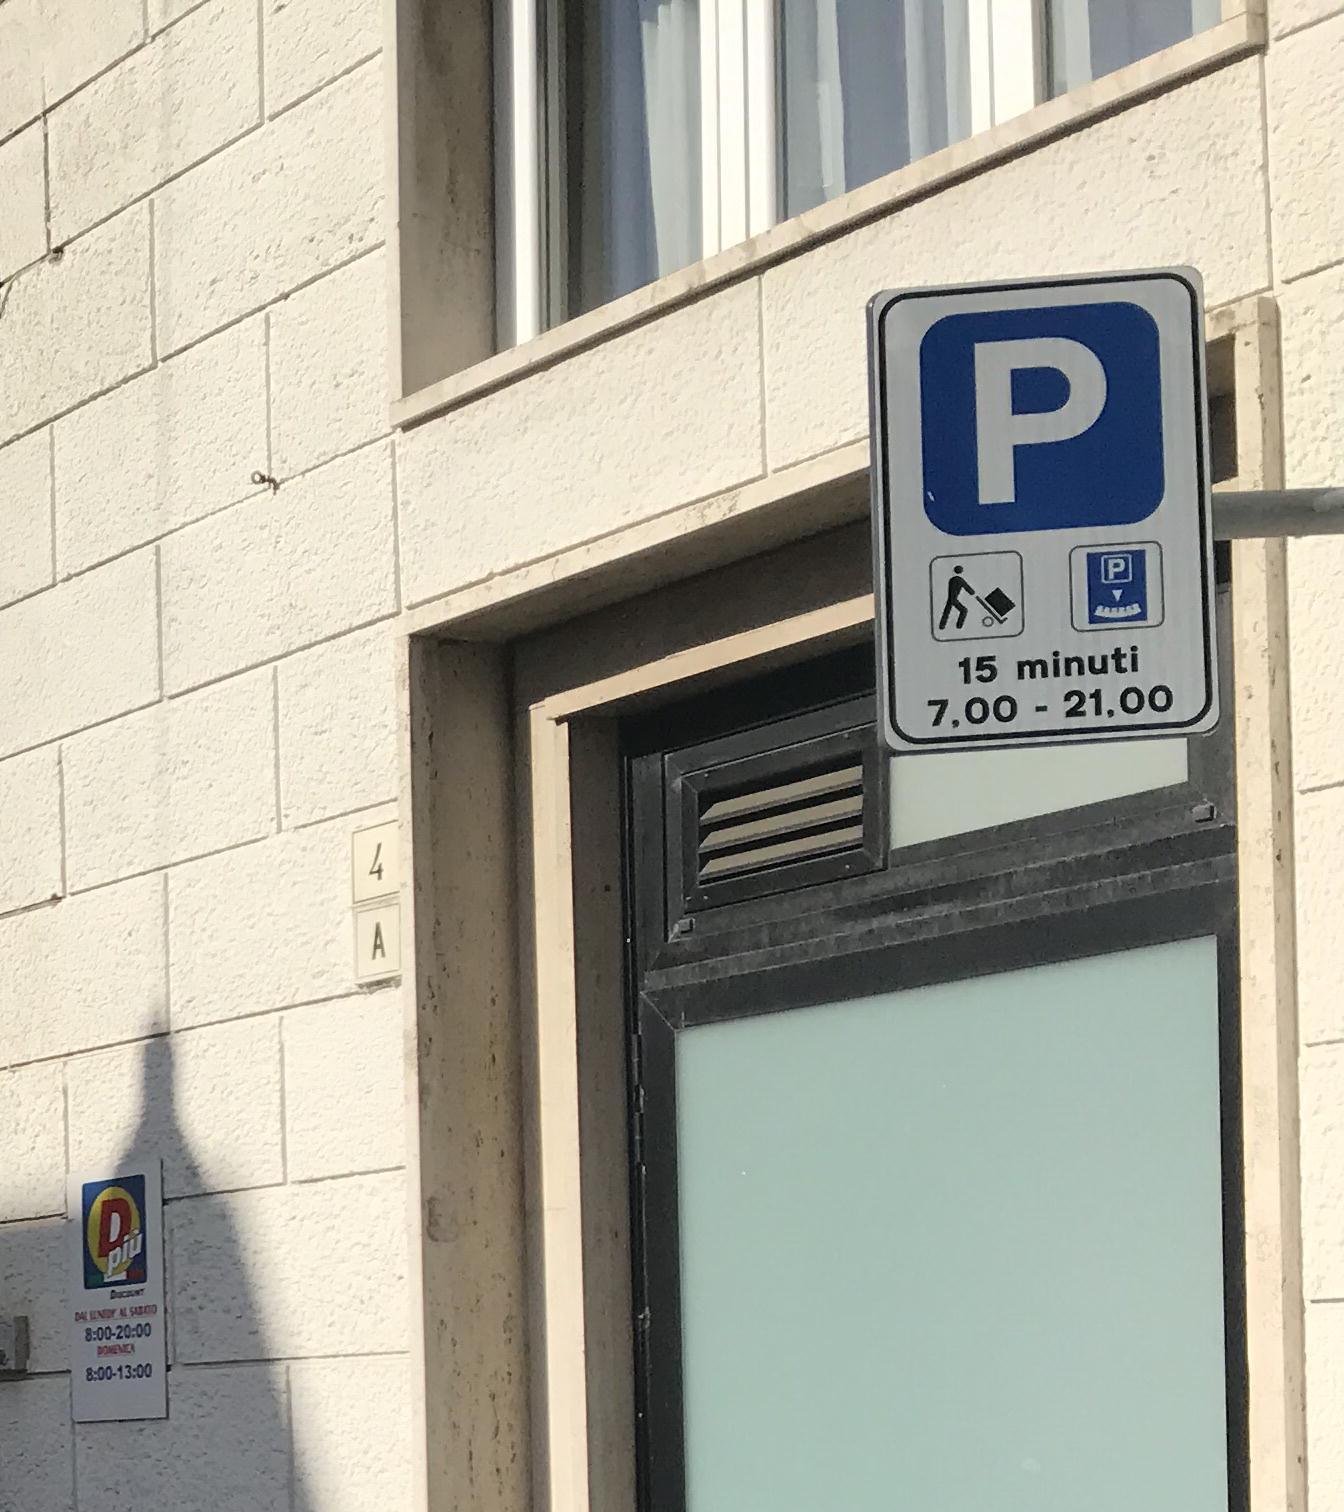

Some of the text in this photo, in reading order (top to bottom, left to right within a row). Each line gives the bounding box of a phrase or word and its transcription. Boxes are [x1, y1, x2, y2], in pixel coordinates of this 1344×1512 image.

[974, 336, 1108, 506] P
[1108, 556, 1127, 580] P
[958, 645, 1140, 685] 15 minuti
[368, 842, 384, 881] 4
[371, 921, 386, 961] A
[84, 1322, 152, 1342] 8:00-20:00
[85, 1362, 152, 1382] 8:00-13:00
